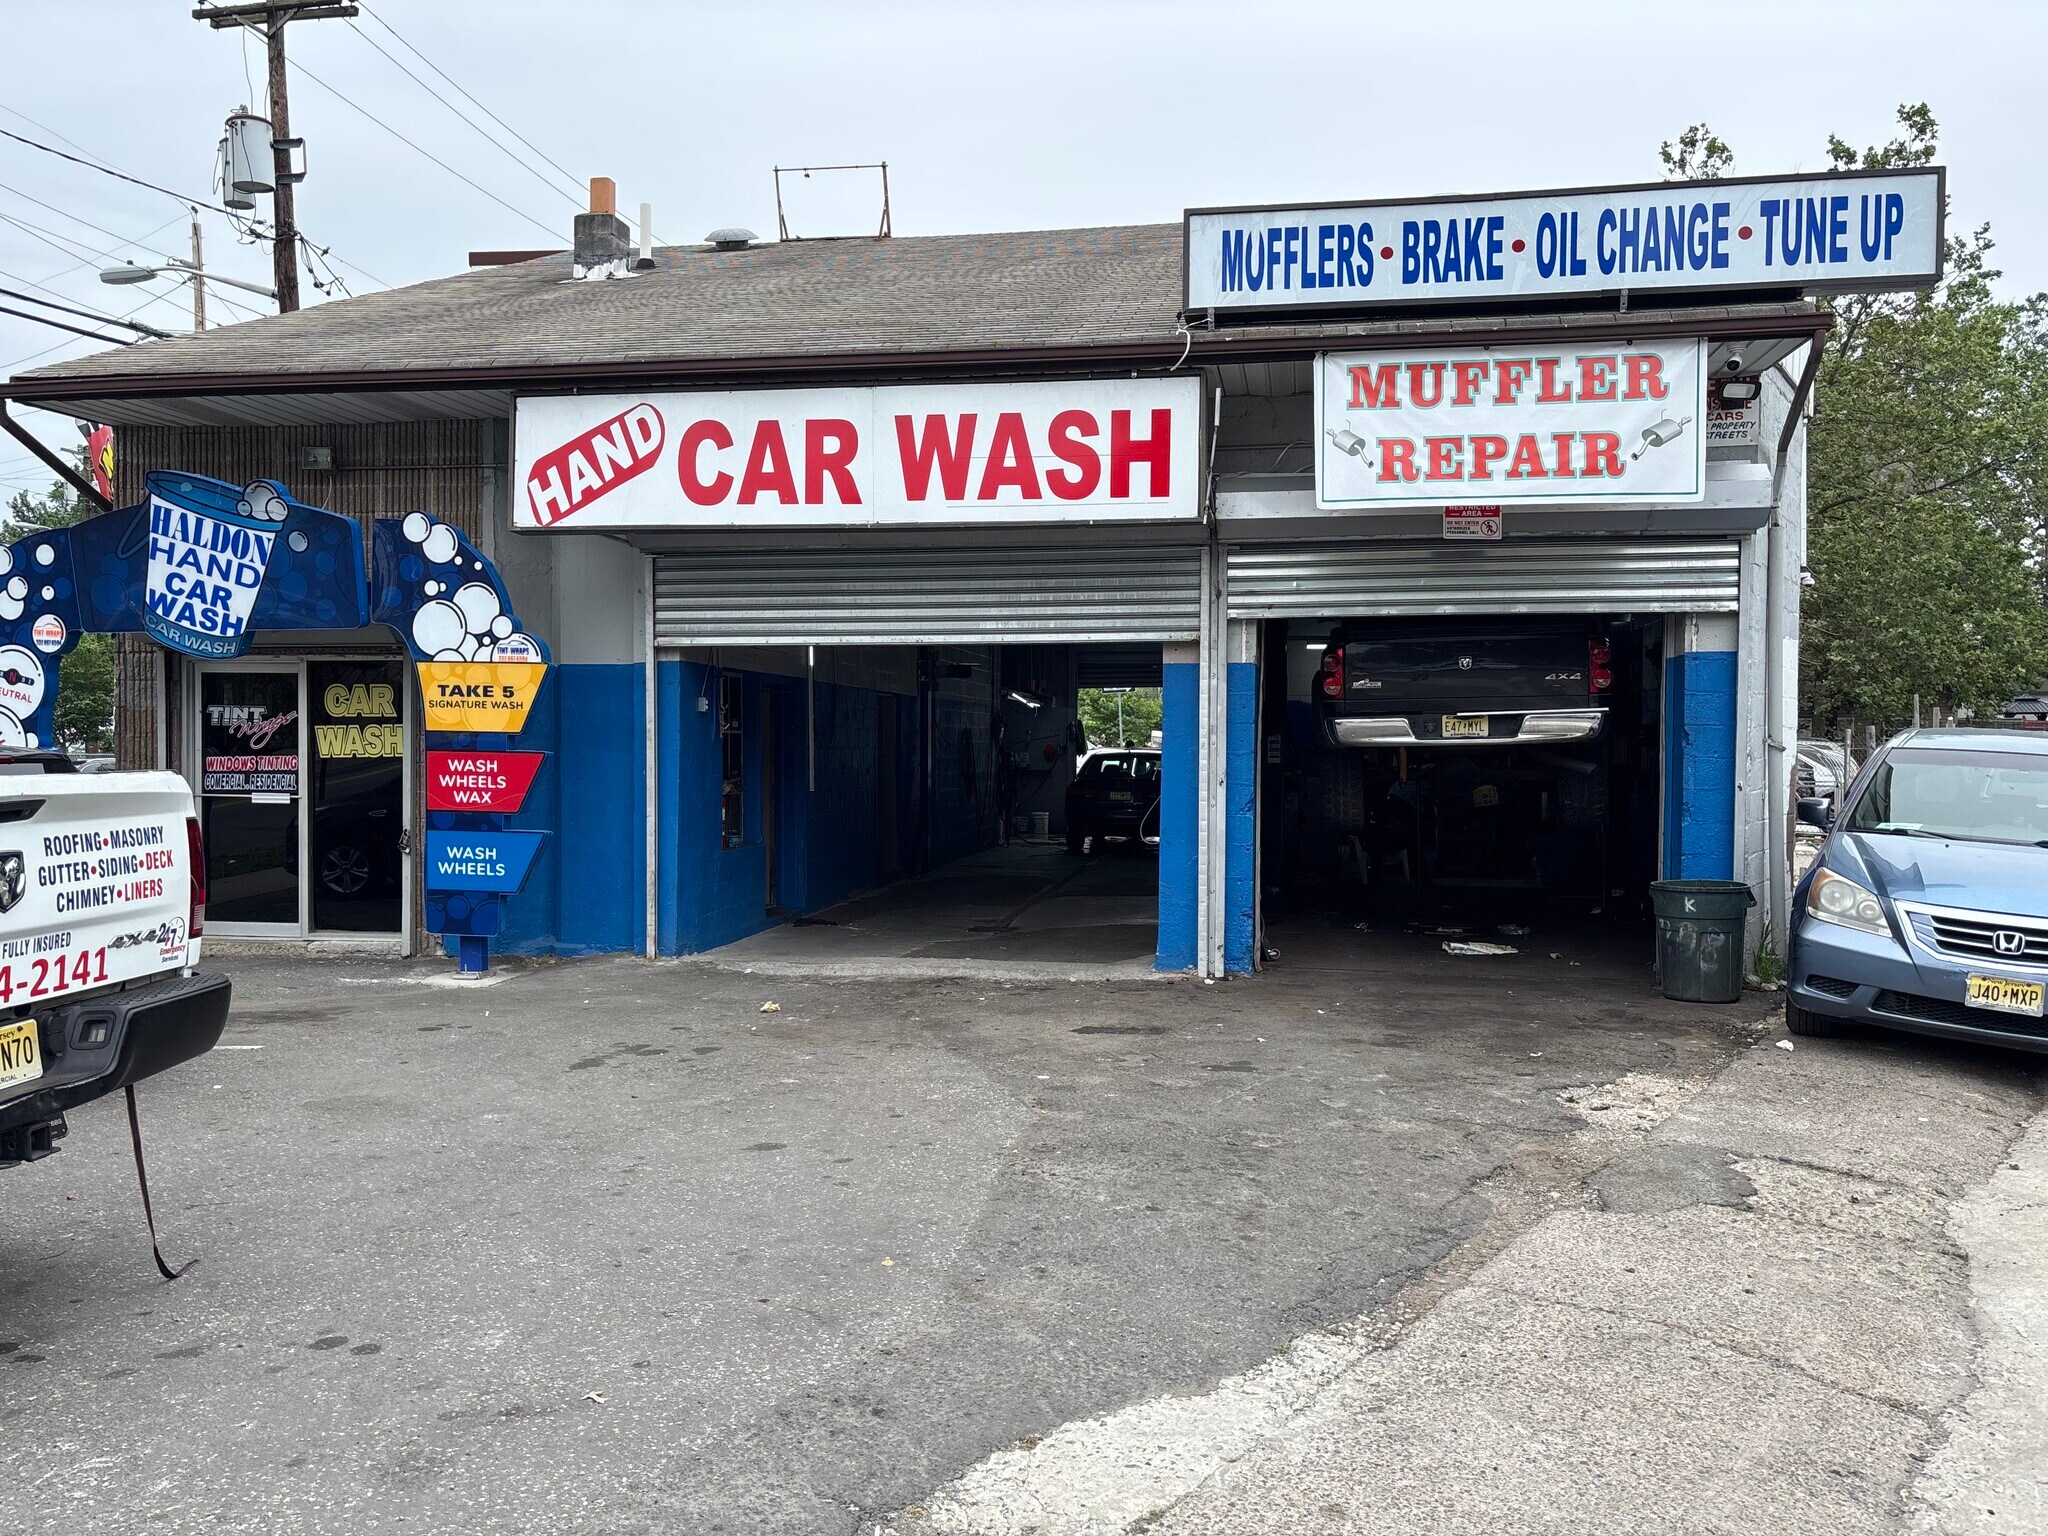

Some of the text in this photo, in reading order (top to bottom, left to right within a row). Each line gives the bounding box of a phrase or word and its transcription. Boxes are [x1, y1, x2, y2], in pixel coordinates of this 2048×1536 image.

[1221, 193, 1904, 292] MUFFLERS BRAKE OIL CHANGE TUNE UP
[1346, 352, 1670, 411] MUFFLER
[1711, 421, 1756, 430] PROPERTY
[528, 404, 1171, 526] HAND CAR WASH
[1376, 430, 1627, 484] REPAIR
[150, 503, 273, 567] HALDON
[150, 537, 261, 589] HAND
[165, 572, 233, 612] CAR
[149, 588, 244, 637] WASH
[145, 614, 181, 643] CAR
[184, 634, 238, 655] WASH
[324, 683, 398, 718] CAR
[428, 700, 523, 709] SIGNATURE WASH
[437, 685, 514, 698] TAKE 5
[205, 704, 298, 750] TINT Wraps
[314, 723, 404, 759] WASH
[206, 755, 298, 771] WINDOWS TINTING
[447, 759, 498, 773] WASH
[250, 773, 297, 790] RESIDENCIAL
[439, 775, 506, 789] WHEELS
[453, 791, 492, 804] WAX
[43, 825, 163, 857] ROOFING MASONRY
[447, 847, 496, 860] WASH
[38, 849, 173, 887] GUTTER SIDING DECK
[437, 862, 505, 876] WHEELS
[56, 878, 163, 913] CHIMNEY LINERS
[1685, 896, 1696, 912] K
[2, 931, 71, 959] FULLY INSURED
[160, 944, 186, 956] Emergency
[161, 955, 179, 963] Services
[1972, 984, 2000, 1001] J40
[2010, 987, 2038, 1006] MXP
